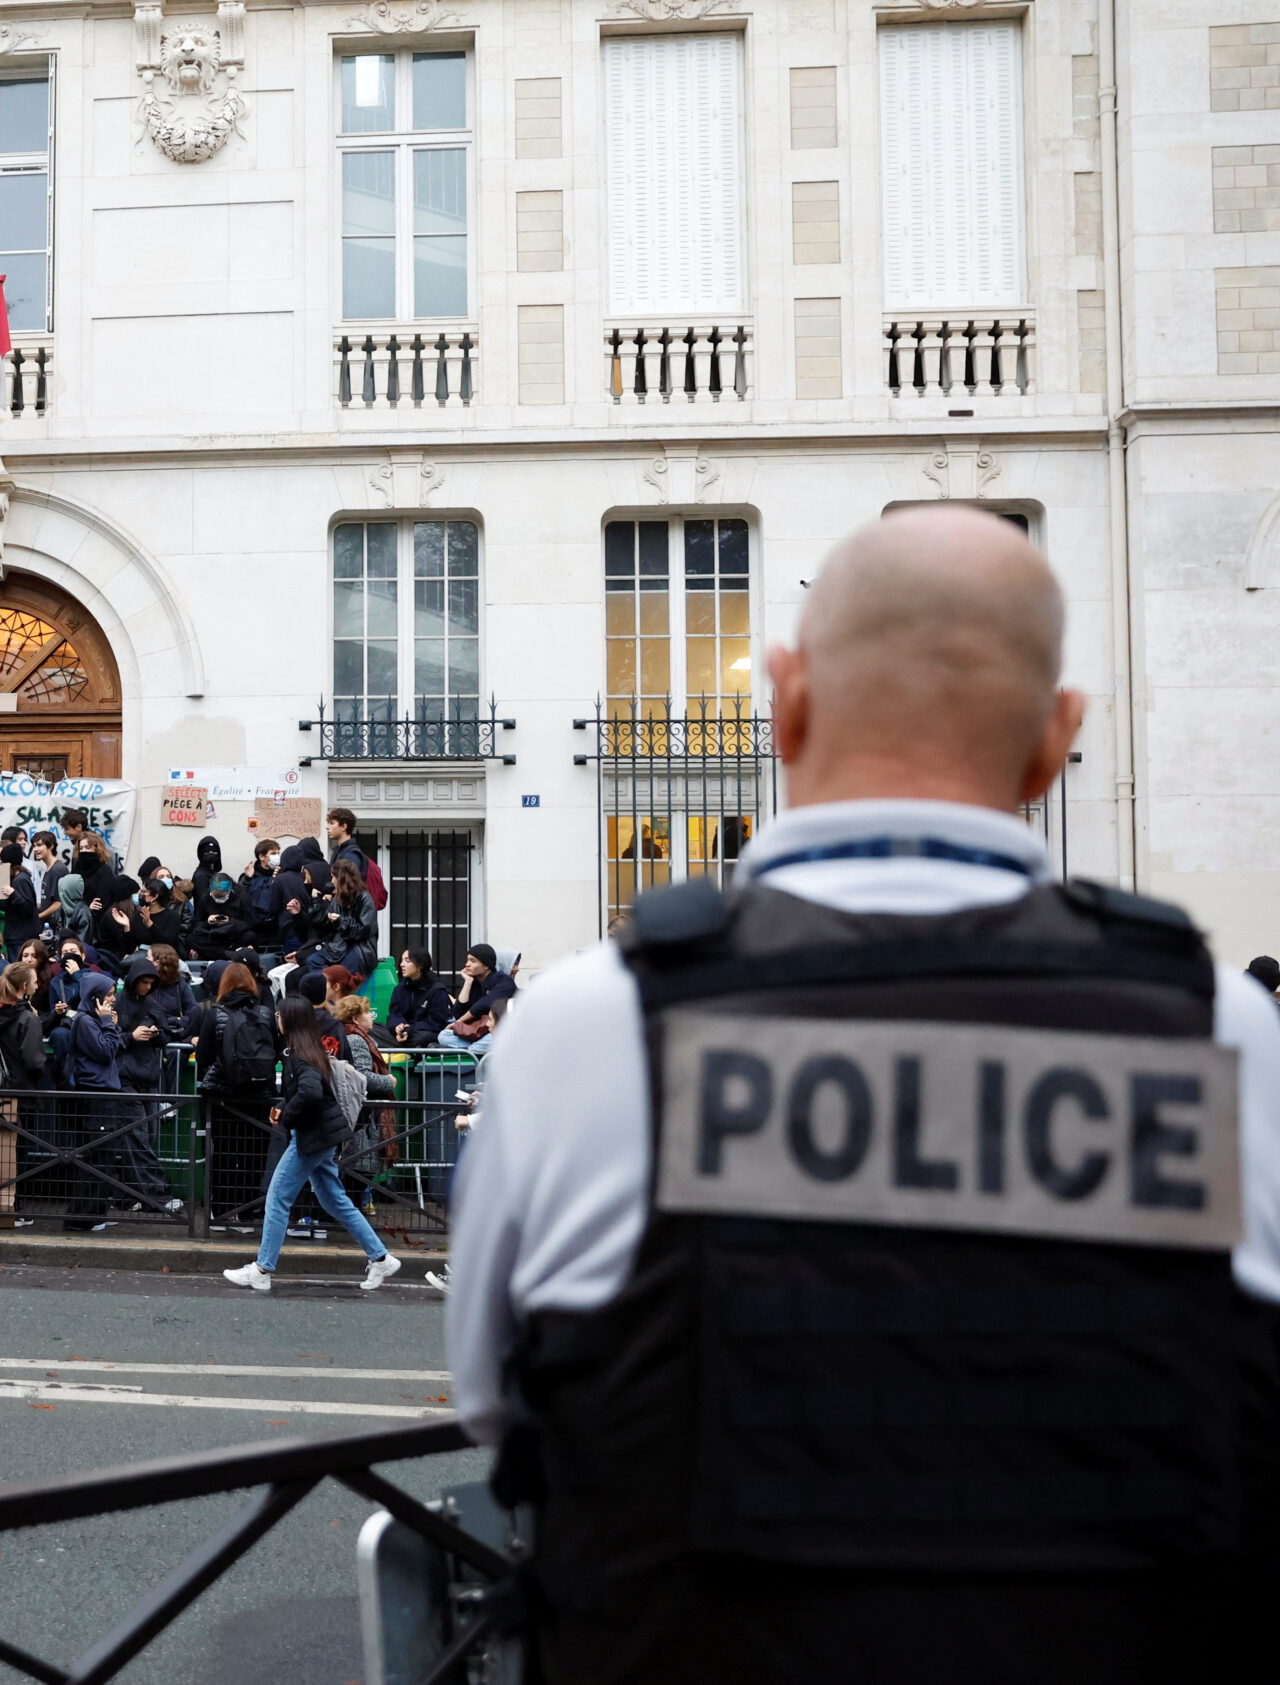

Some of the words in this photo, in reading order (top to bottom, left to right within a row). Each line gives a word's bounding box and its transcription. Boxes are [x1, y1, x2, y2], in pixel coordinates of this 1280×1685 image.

[213, 786, 243, 796] Égalité
[255, 786, 300, 796] Fratité
[163, 798, 192, 809] PIÈGE
[196, 798, 203, 810] À
[260, 800, 278, 809] LE
[284, 799, 319, 809] LEVES
[525, 796, 537, 806] 19
[168, 810, 198, 822] CONS
[695, 1048, 1208, 1212] POLICE
